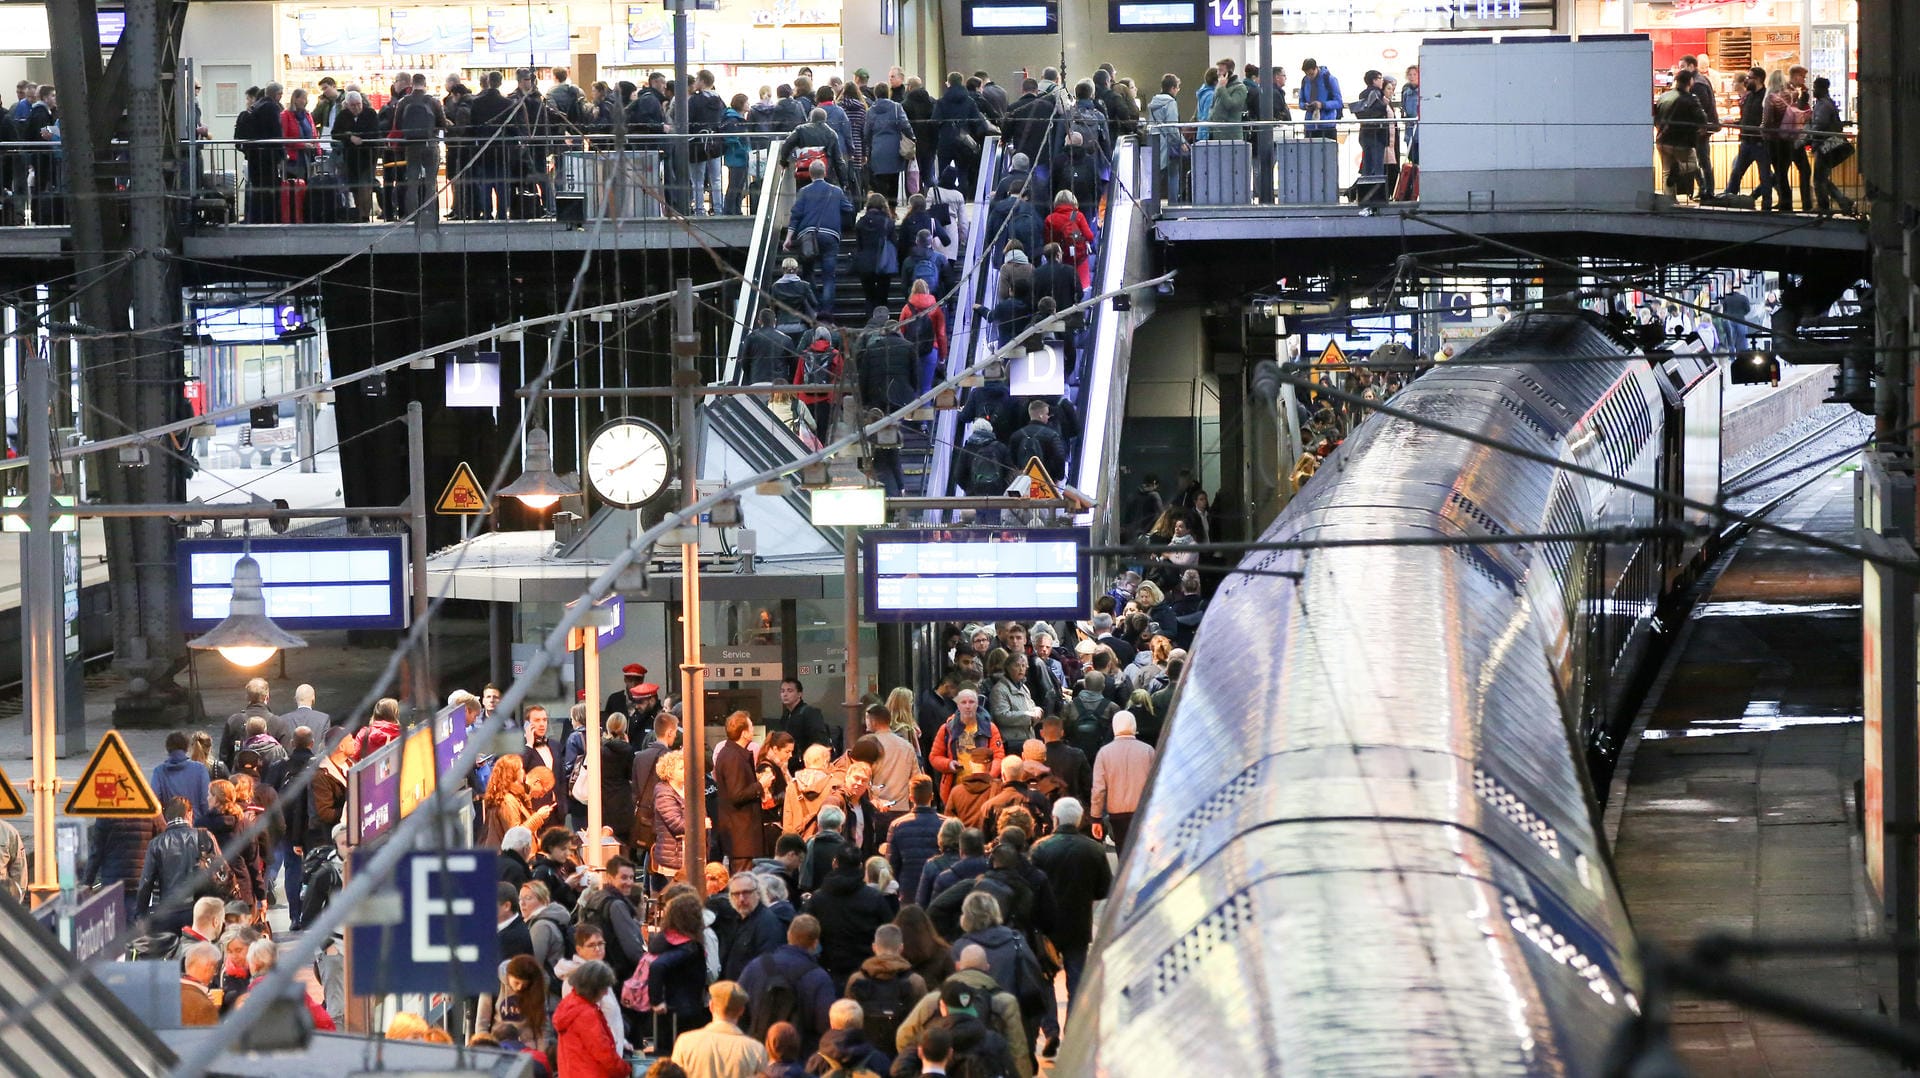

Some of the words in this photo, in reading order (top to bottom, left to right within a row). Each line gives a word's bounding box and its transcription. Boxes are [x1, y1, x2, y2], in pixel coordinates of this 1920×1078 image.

[1208, 0, 1242, 27] 14
[280, 306, 300, 331] C
[1450, 293, 1467, 317] C
[453, 355, 482, 394] D
[1028, 344, 1057, 382] D
[722, 650, 752, 659] Service
[411, 855, 480, 962] E
[76, 918, 104, 962] Hamburg
[104, 902, 116, 945] Hbf
